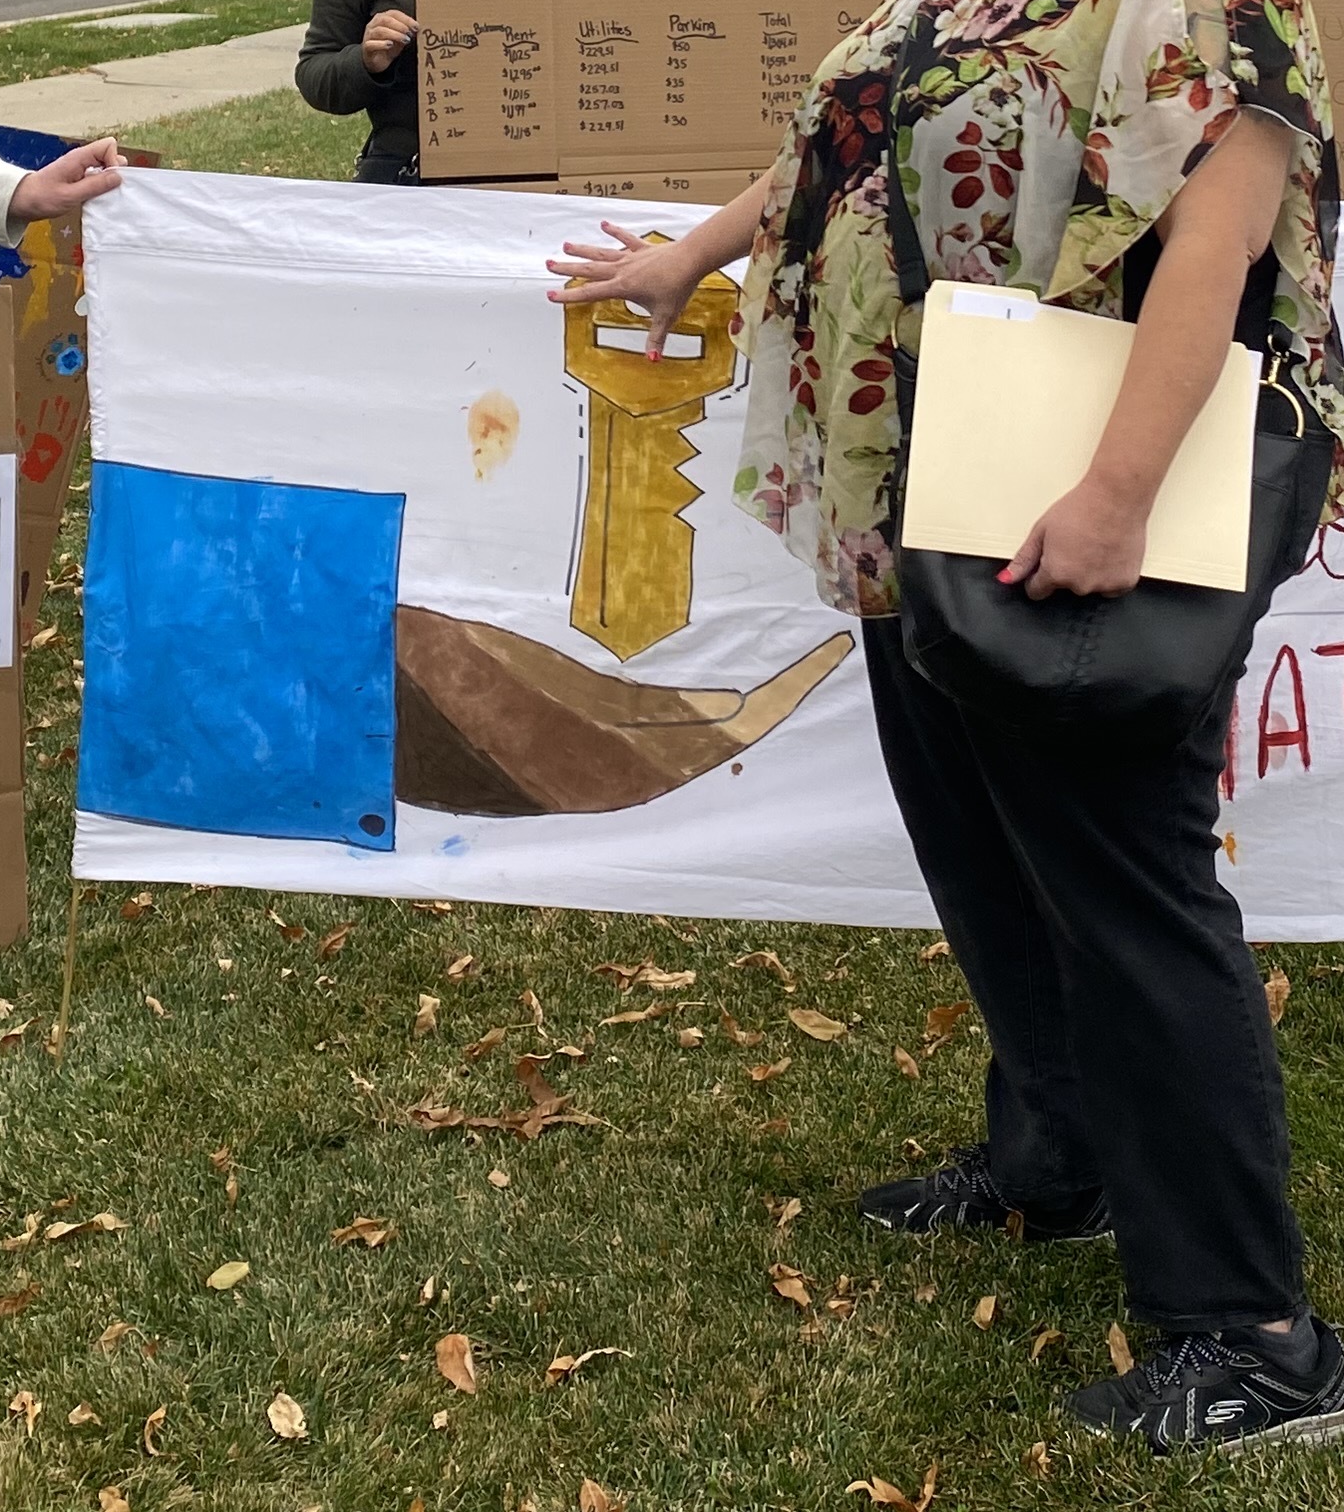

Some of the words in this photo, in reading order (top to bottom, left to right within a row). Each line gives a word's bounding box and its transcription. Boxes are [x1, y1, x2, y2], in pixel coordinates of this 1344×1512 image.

[505, 25, 537, 42] Rent
[578, 20, 633, 38] Utilities
[669, 14, 717, 35] Parking
[758, 12, 792, 28] Total
[424, 52, 436, 70] A
[672, 40, 691, 52] $50
[425, 72, 435, 87] A
[666, 55, 688, 70] $35
[426, 91, 437, 105] B
[665, 76, 685, 88] $35
[426, 108, 438, 123] B
[666, 92, 685, 104] $35
[428, 130, 439, 147] A
[446, 127, 466, 138] 2br
[664, 114, 688, 127] $30
[663, 176, 690, 190] $50
